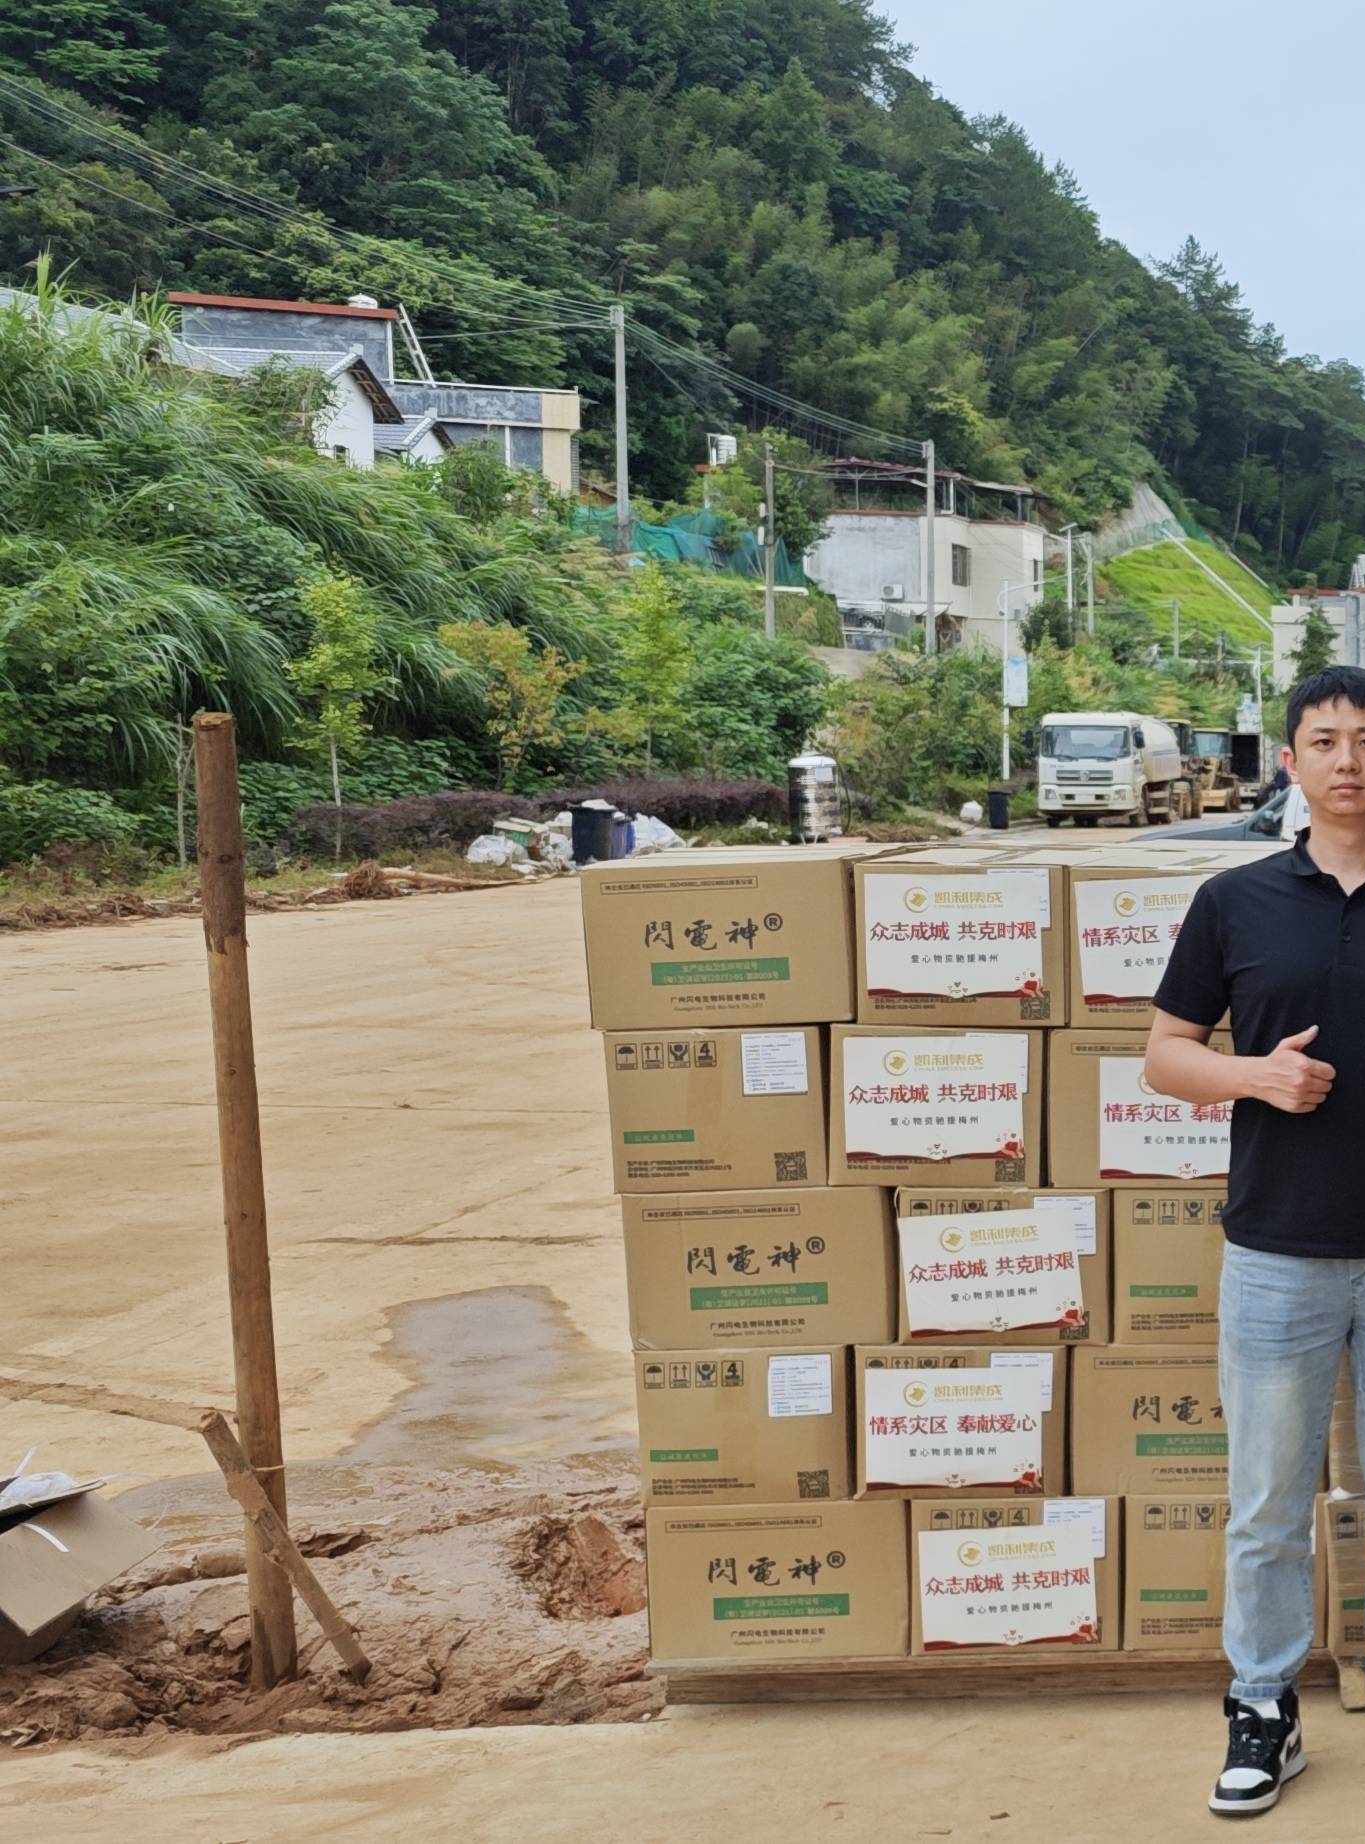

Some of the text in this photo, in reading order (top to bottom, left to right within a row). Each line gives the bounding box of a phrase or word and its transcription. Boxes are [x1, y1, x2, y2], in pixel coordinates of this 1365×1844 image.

[870, 920, 1037, 941] 众志成城 共克时艰
[1082, 924, 1160, 948] 情系灾区
[849, 1083, 1018, 1104] 众志成城 共克时艰
[1104, 1103, 1233, 1123] 情系灾区 奉献
[909, 1251, 1075, 1284] 众志成城 共克时艰
[870, 1413, 1037, 1436] 情系灾区 奉献爱心
[925, 1567, 1090, 1597] 众志成城 共克时艰
